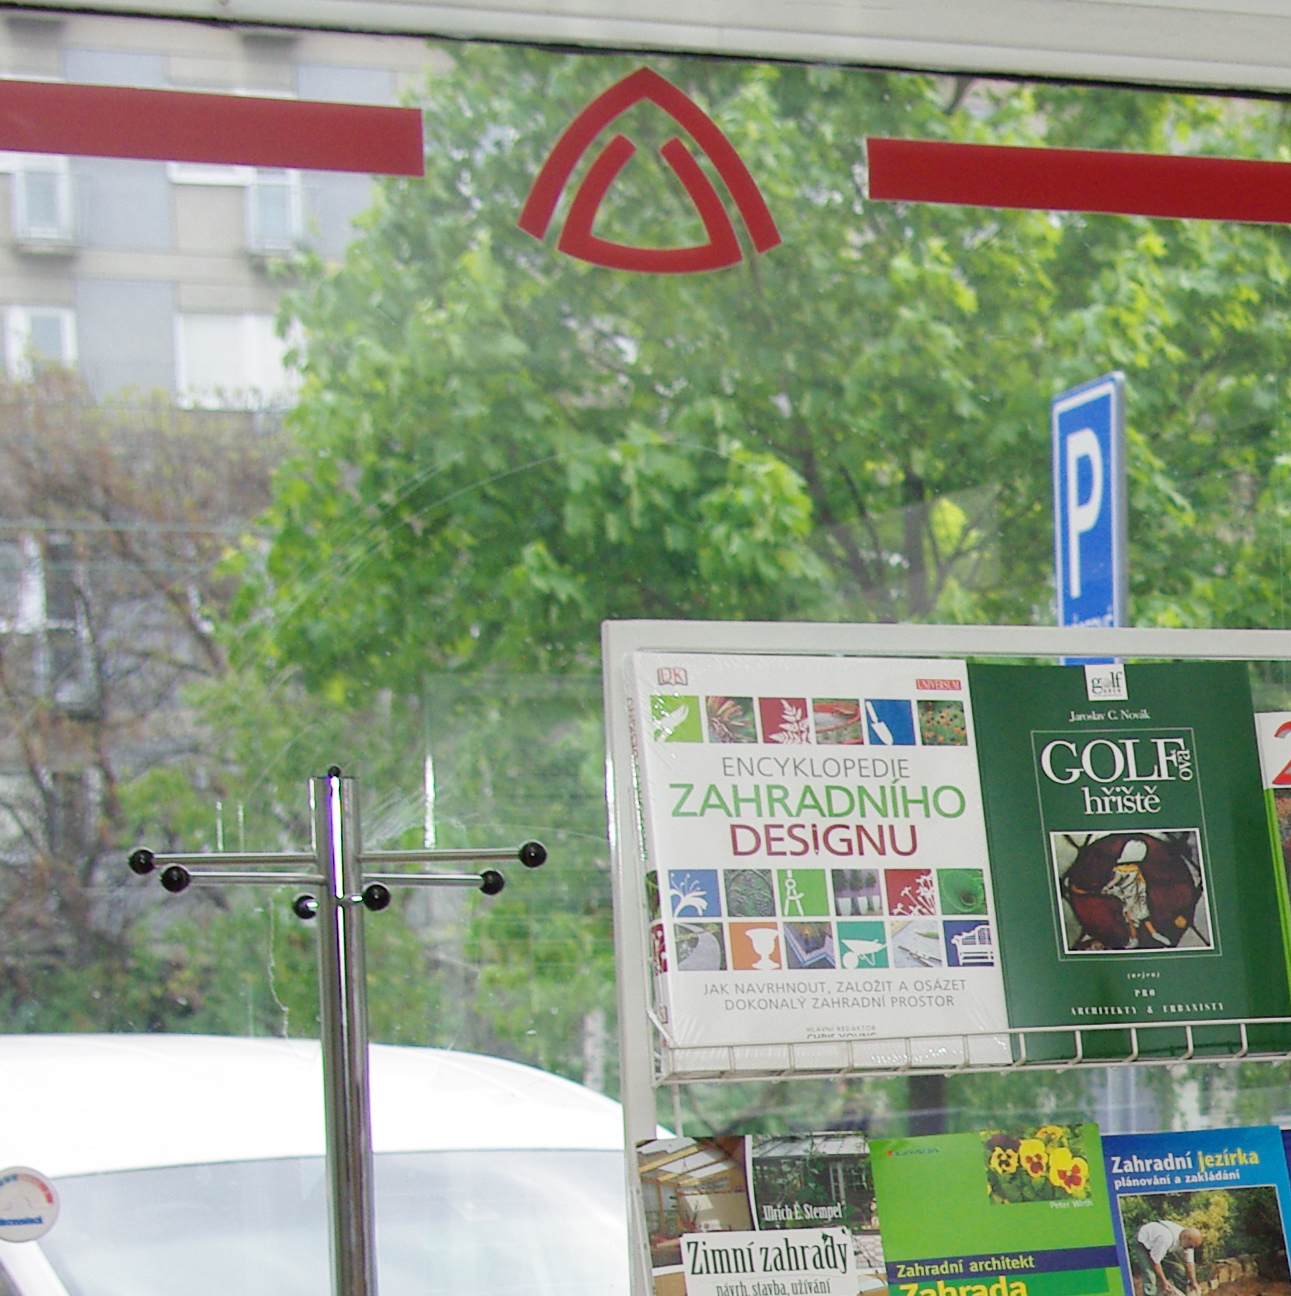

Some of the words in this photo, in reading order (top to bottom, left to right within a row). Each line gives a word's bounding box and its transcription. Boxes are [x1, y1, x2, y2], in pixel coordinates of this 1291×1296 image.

[1067, 428, 1102, 599] P
[1069, 710, 1105, 723] Jaroslav
[1109, 711, 1118, 721] C.
[1121, 708, 1150, 721] Novák
[722, 756, 910, 779] ENCYKLOPEDIE
[1041, 738, 1187, 783] GOLF
[670, 779, 966, 818] ZAHRADNÍHO
[1083, 785, 1161, 814] hřiště
[731, 824, 918, 857] DESIGNU
[704, 984, 730, 996] JAK
[734, 982, 830, 996] NAVRHNOUT,
[836, 978, 893, 994] ZALOŽIT
[898, 981, 908, 992] A
[912, 977, 967, 992] OSÁZET
[725, 995, 807, 1010] DOKONALÝ
[811, 994, 885, 1010] ZAHRADNÍ
[891, 995, 954, 1009] PROSTOR
[1111, 1151, 1192, 1174] Zahradní
[1199, 1149, 1259, 1170] jezírka
[687, 1240, 756, 1275] Zimní
[759, 1236, 848, 1275] zahrady
[897, 1258, 964, 1278] Zahradní
[969, 1255, 1035, 1272] architekt
[752, 1280, 789, 1296] stavba,
[792, 1278, 830, 1295] užívání
